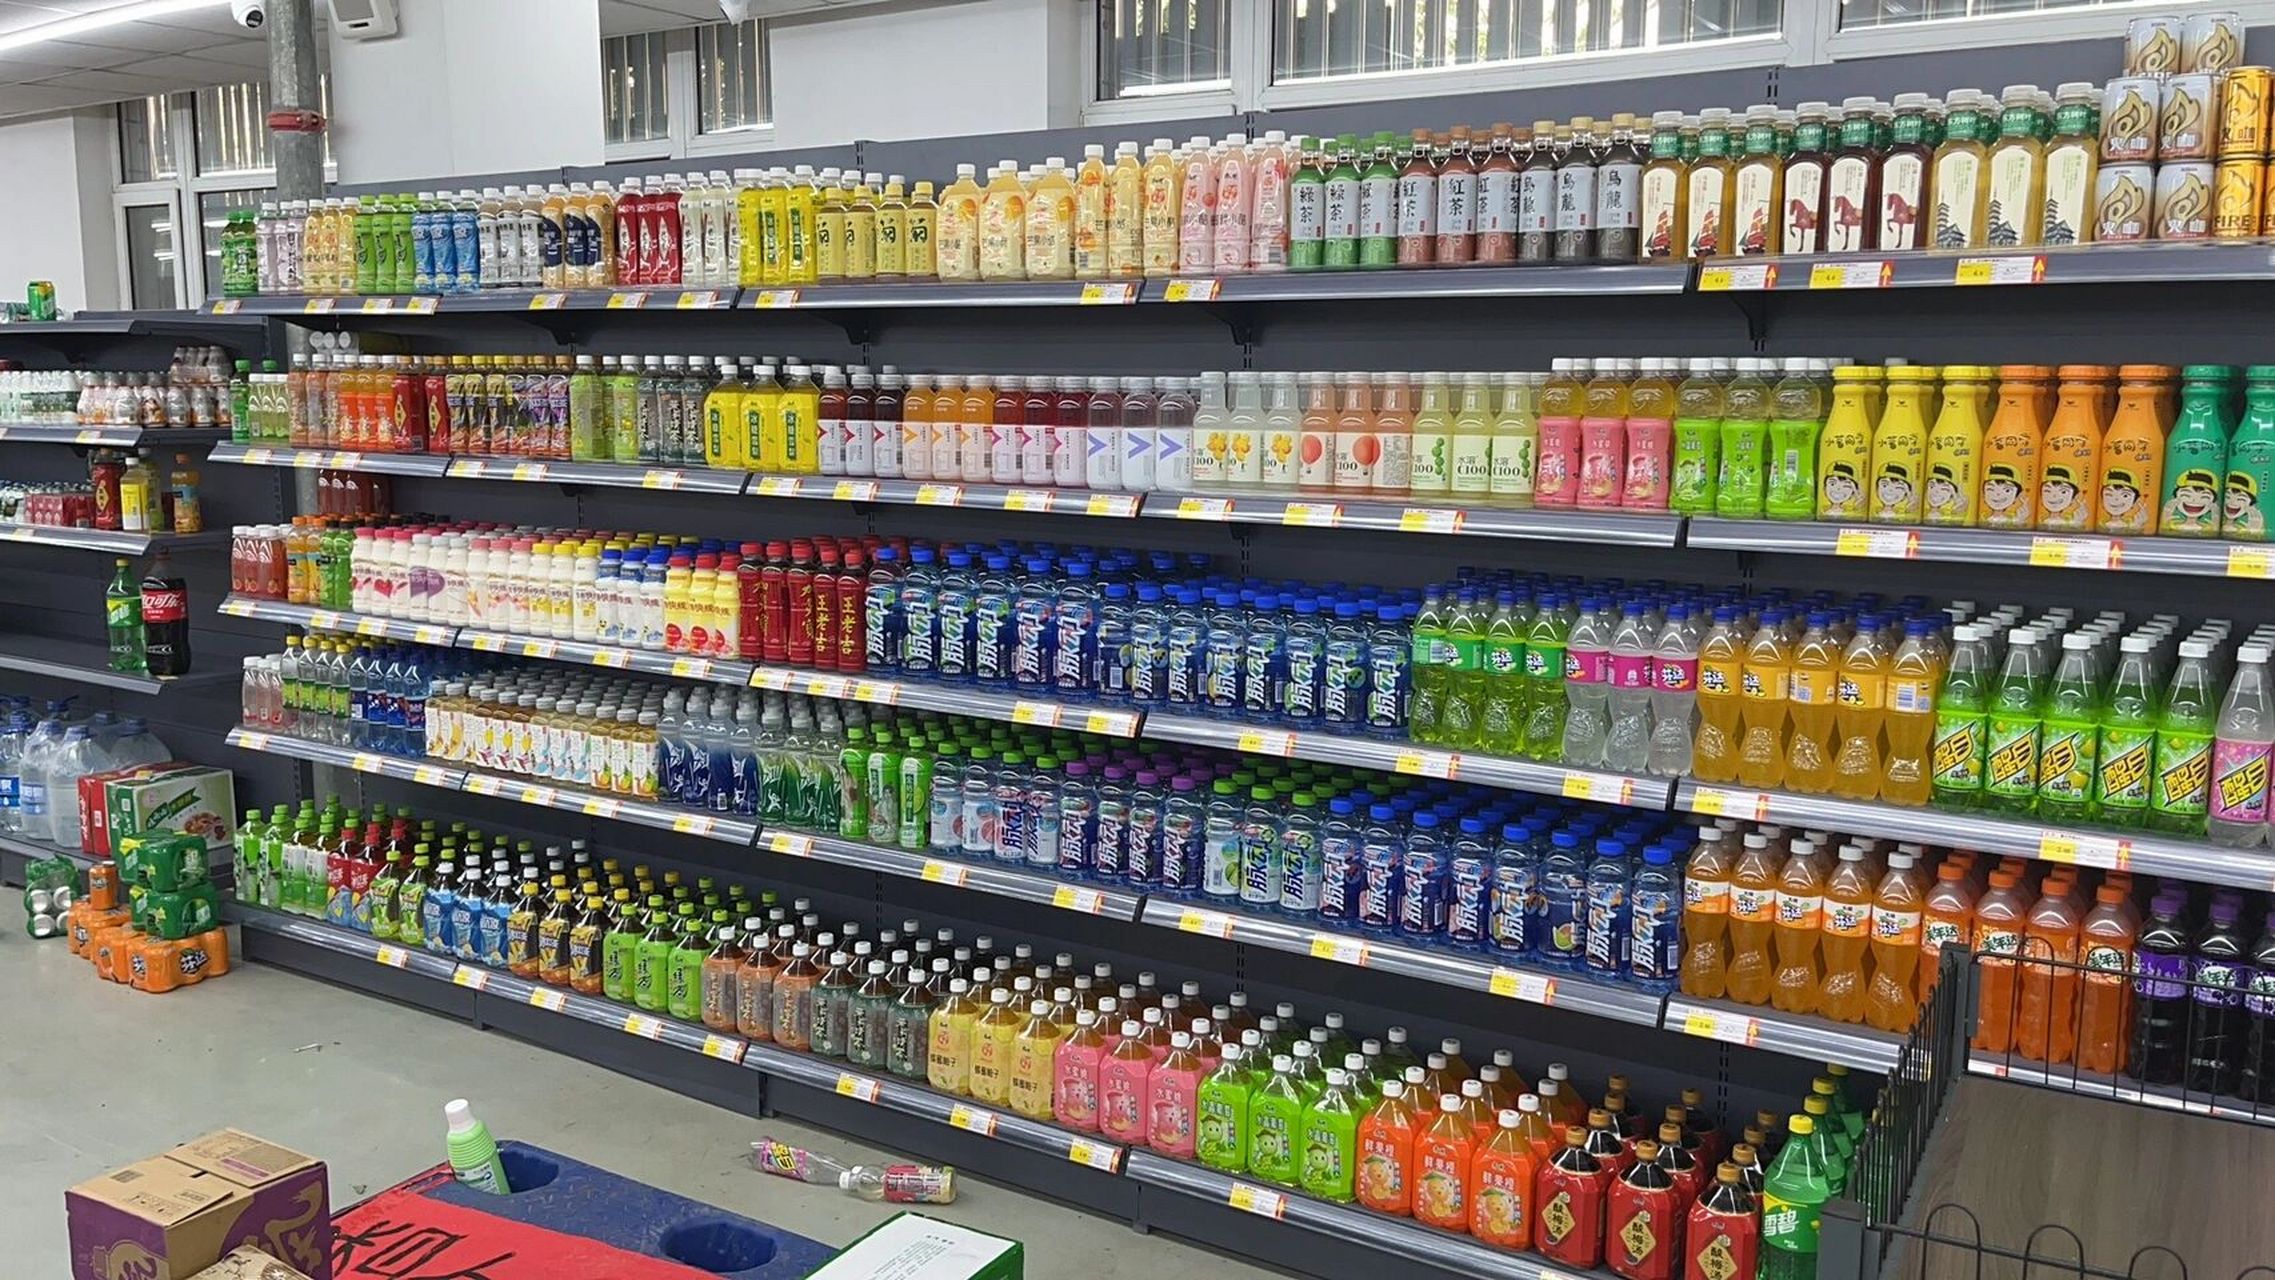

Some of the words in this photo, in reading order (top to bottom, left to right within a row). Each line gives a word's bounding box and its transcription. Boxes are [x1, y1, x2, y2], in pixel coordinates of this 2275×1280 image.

[2214, 214, 2251, 227] FIRE
[1457, 464, 1487, 475] C100
[815, 594, 831, 653] 王老吉
[840, 596, 857, 656] 王老吉
[2103, 744, 2148, 792] 醒目
[2221, 759, 2267, 808] 醒目
[1763, 1208, 1799, 1237] 雪碧
